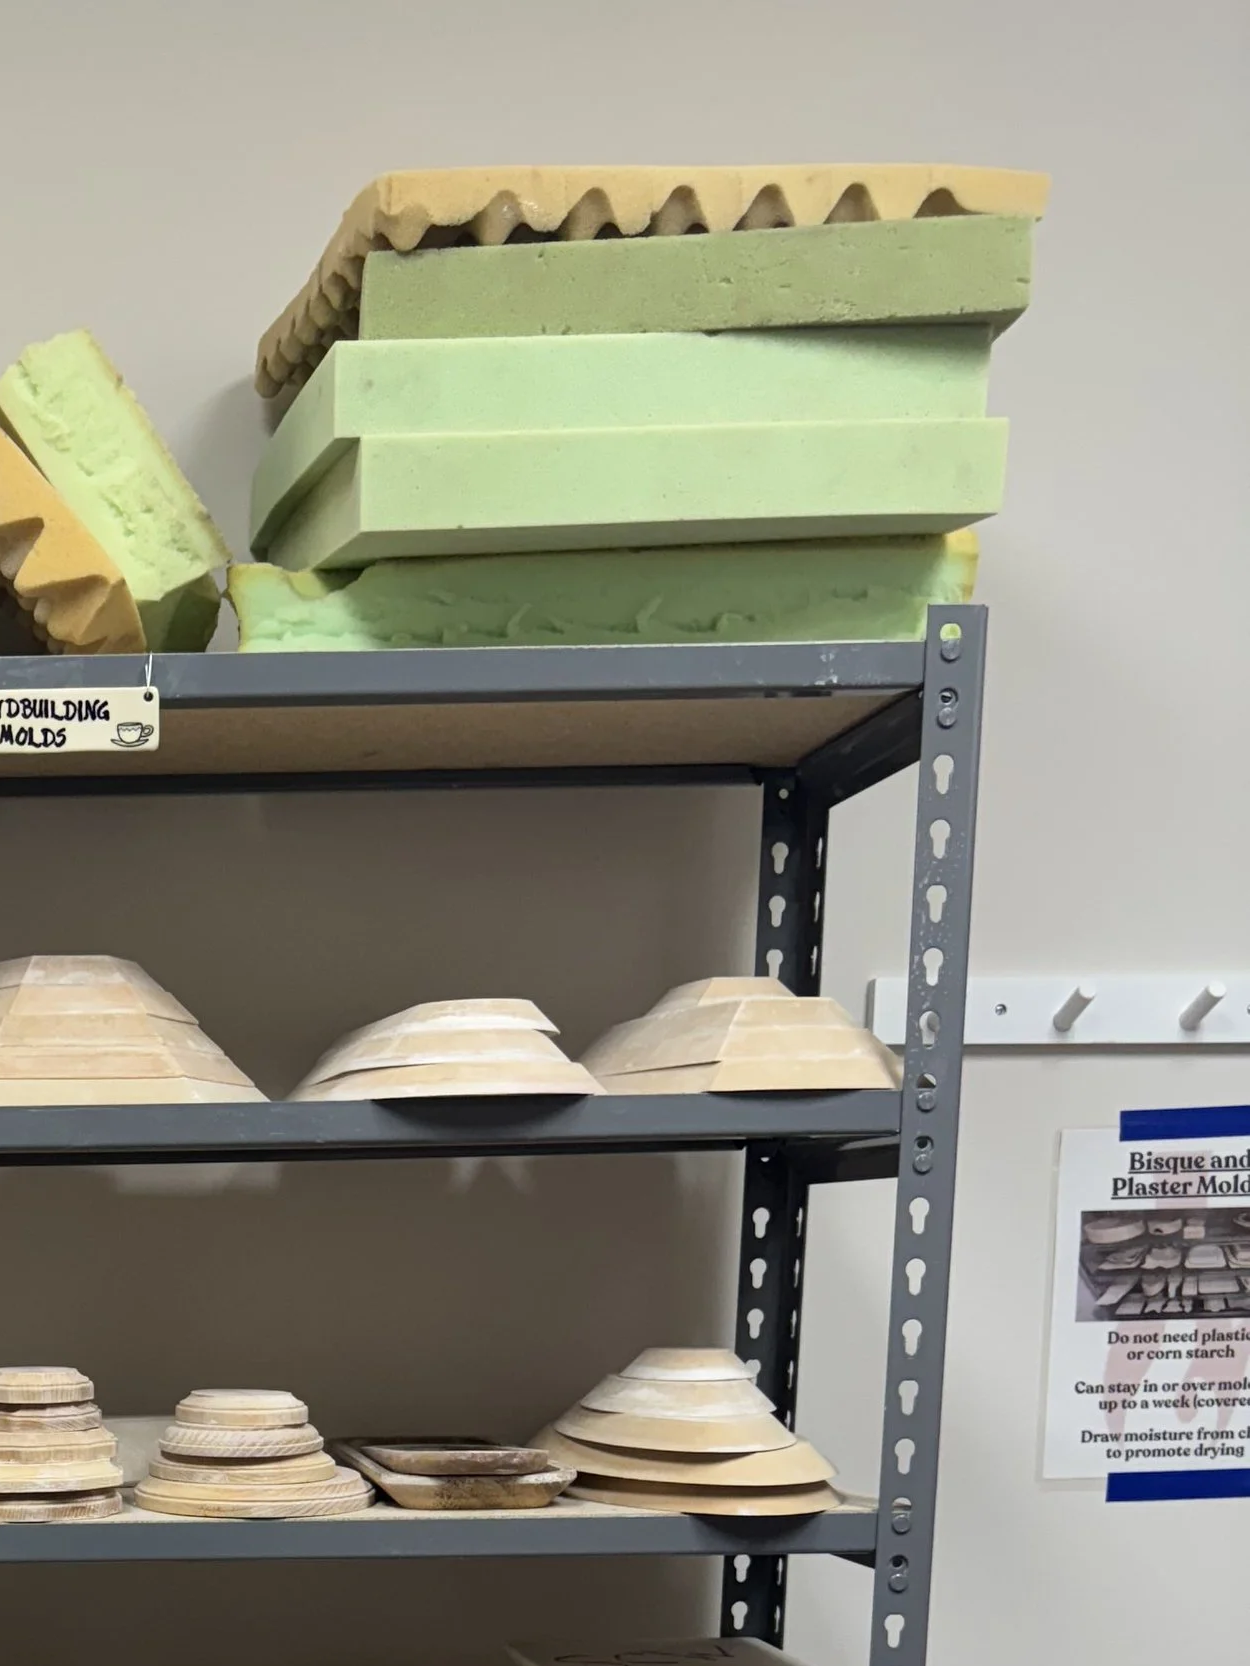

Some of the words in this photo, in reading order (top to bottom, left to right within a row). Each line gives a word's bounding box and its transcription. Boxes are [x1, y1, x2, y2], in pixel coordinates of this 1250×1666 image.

[1128, 1151, 1205, 1175] Bisque
[1112, 1175, 1193, 1197] Plaster
[1107, 1331, 1130, 1344] Do
[1132, 1333, 1159, 1344] not
[1162, 1330, 1198, 1343] need
[1126, 1350, 1144, 1361] or
[1146, 1349, 1182, 1360] corn
[1185, 1345, 1235, 1359] starch
[1074, 1381, 1105, 1394] Can
[1108, 1382, 1141, 1396] stay
[1143, 1379, 1158, 1393] in
[1161, 1381, 1179, 1392] or
[1181, 1380, 1216, 1391] over
[1098, 1400, 1118, 1413] up
[1121, 1398, 1138, 1409] to
[1140, 1399, 1149, 1409] a
[1152, 1395, 1190, 1408] week
[1080, 1430, 1122, 1443] Draw
[1123, 1428, 1193, 1442] moisture
[1196, 1426, 1235, 1441] from
[1106, 1447, 1122, 1458] to
[1124, 1445, 1191, 1461] promote
[1194, 1443, 1245, 1460] drying
